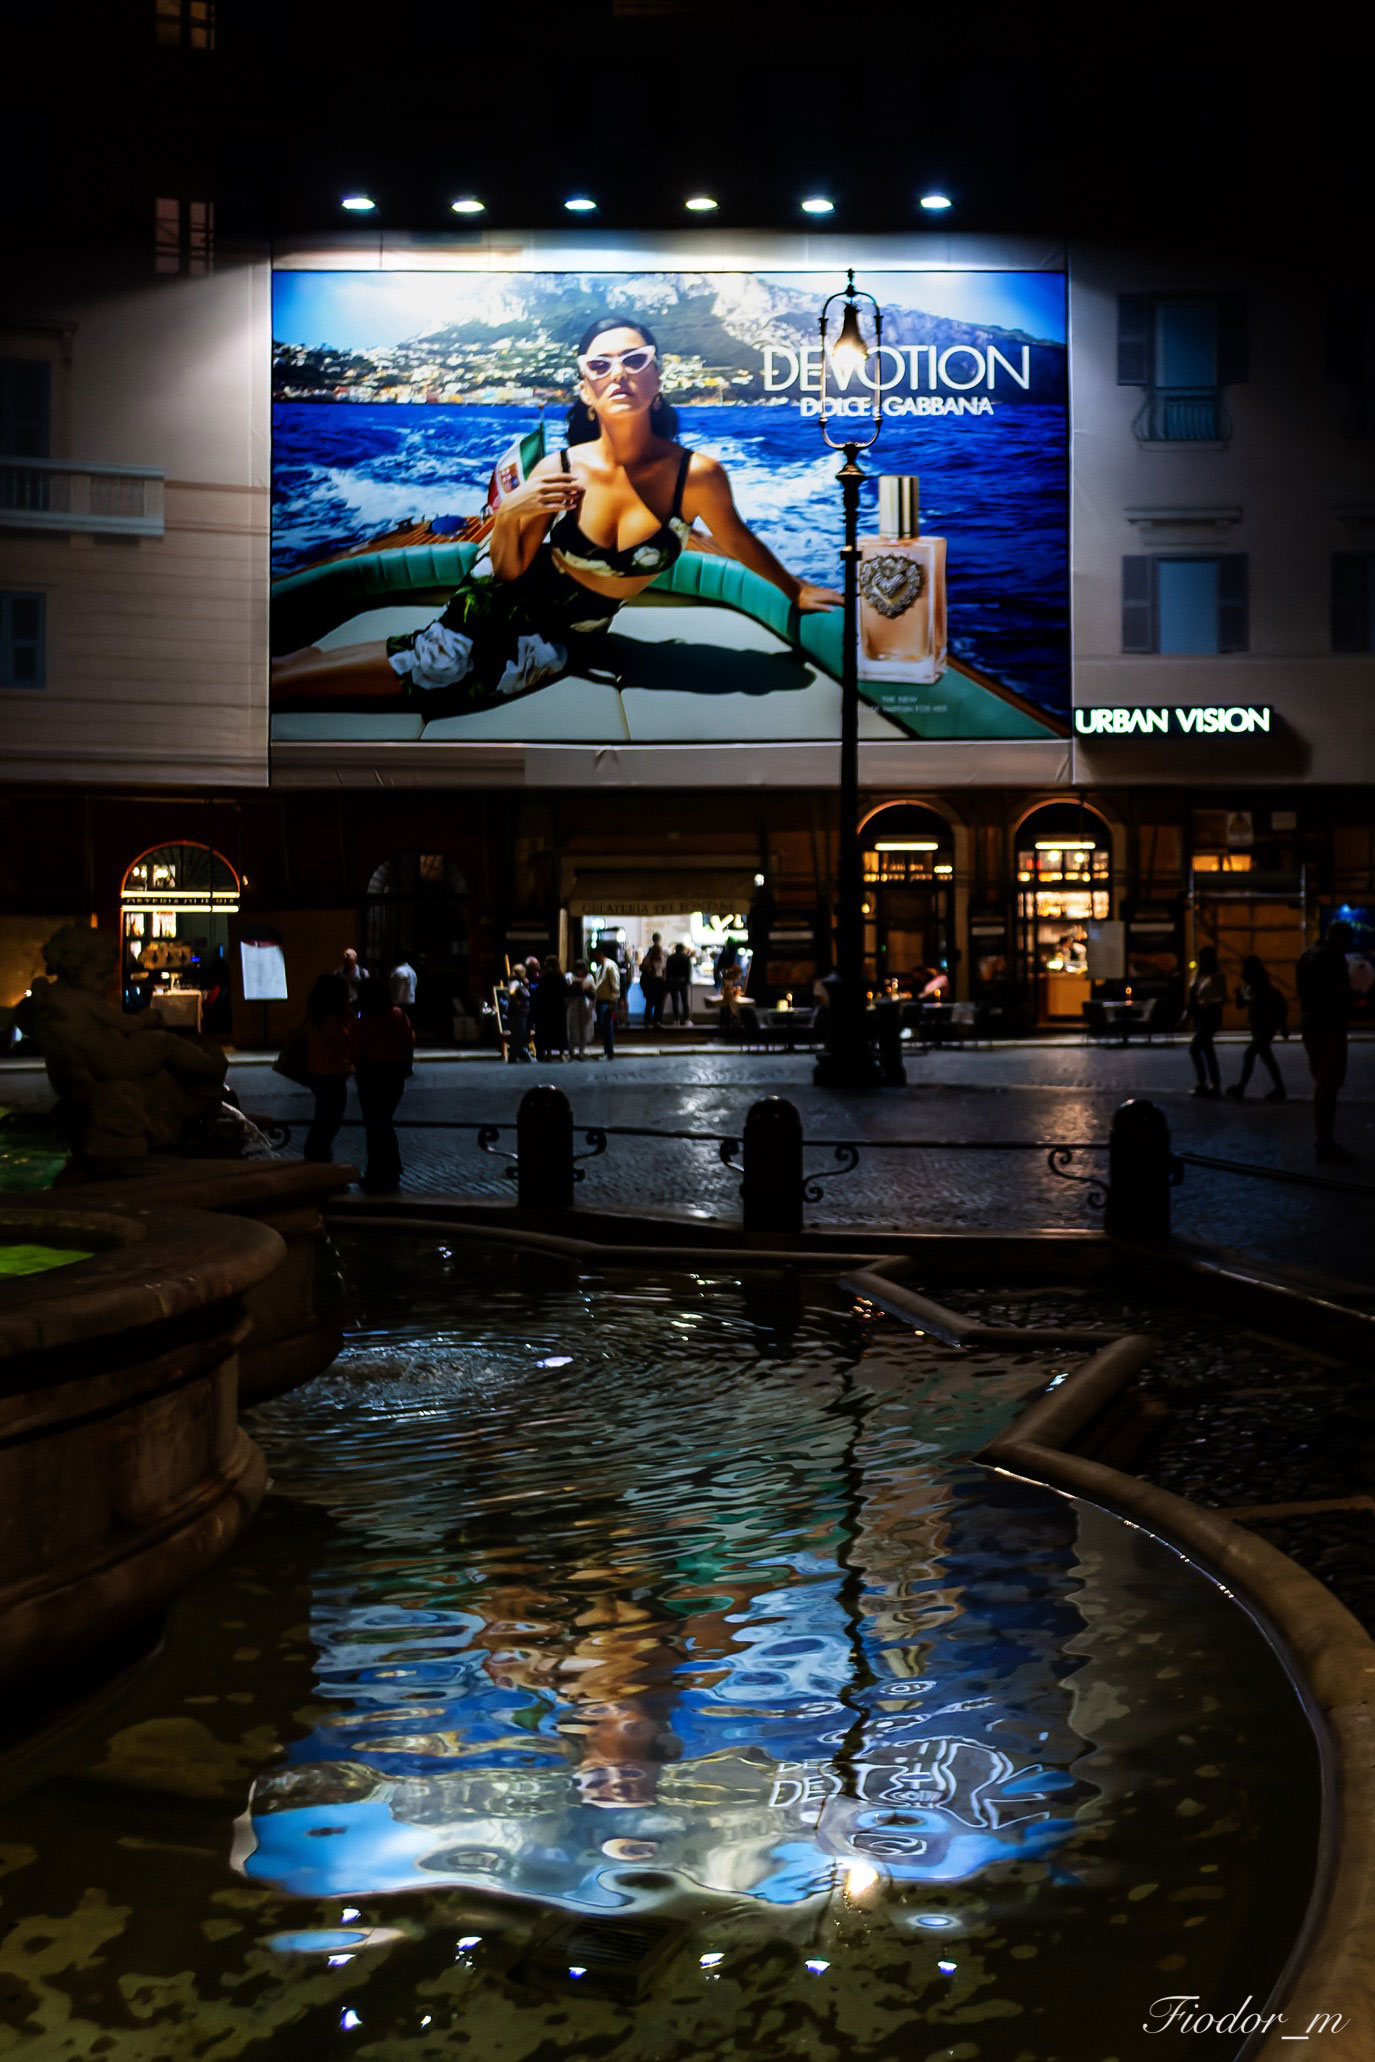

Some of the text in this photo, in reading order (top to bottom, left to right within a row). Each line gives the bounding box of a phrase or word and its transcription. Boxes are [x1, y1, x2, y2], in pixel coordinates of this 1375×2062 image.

[763, 345, 1030, 391] DEVOTION
[800, 397, 871, 417] DOLCE
[882, 396, 994, 416] GABBANA
[1075, 707, 1270, 734] URBAN VISION
